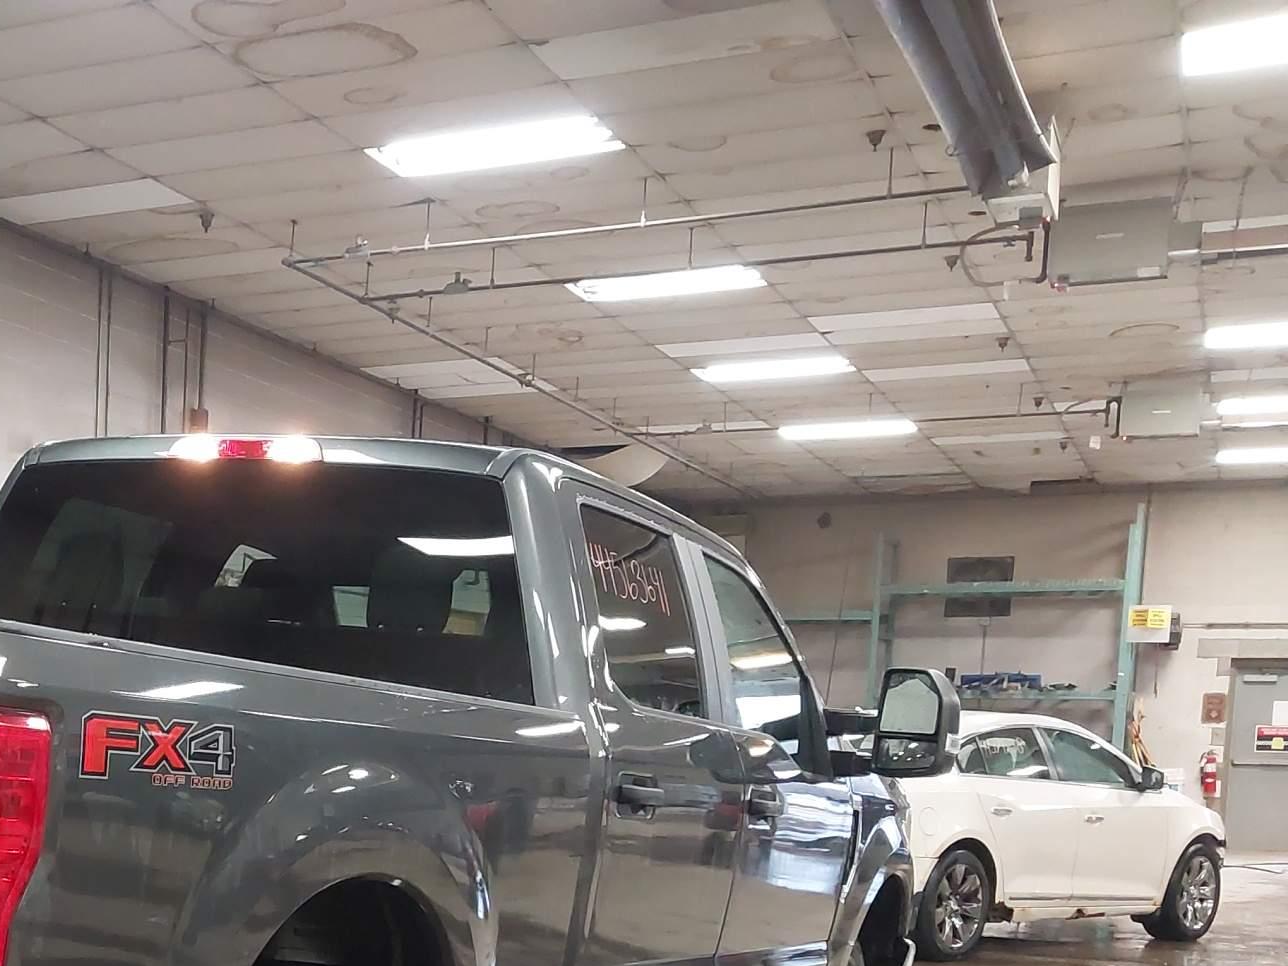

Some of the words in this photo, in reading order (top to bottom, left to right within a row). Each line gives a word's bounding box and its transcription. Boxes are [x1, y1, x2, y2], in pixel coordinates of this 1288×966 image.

[589, 542, 671, 617] 44563641
[79, 710, 236, 780] FX4
[152, 773, 185, 788] OFF
[190, 776, 233, 790] ROAD
